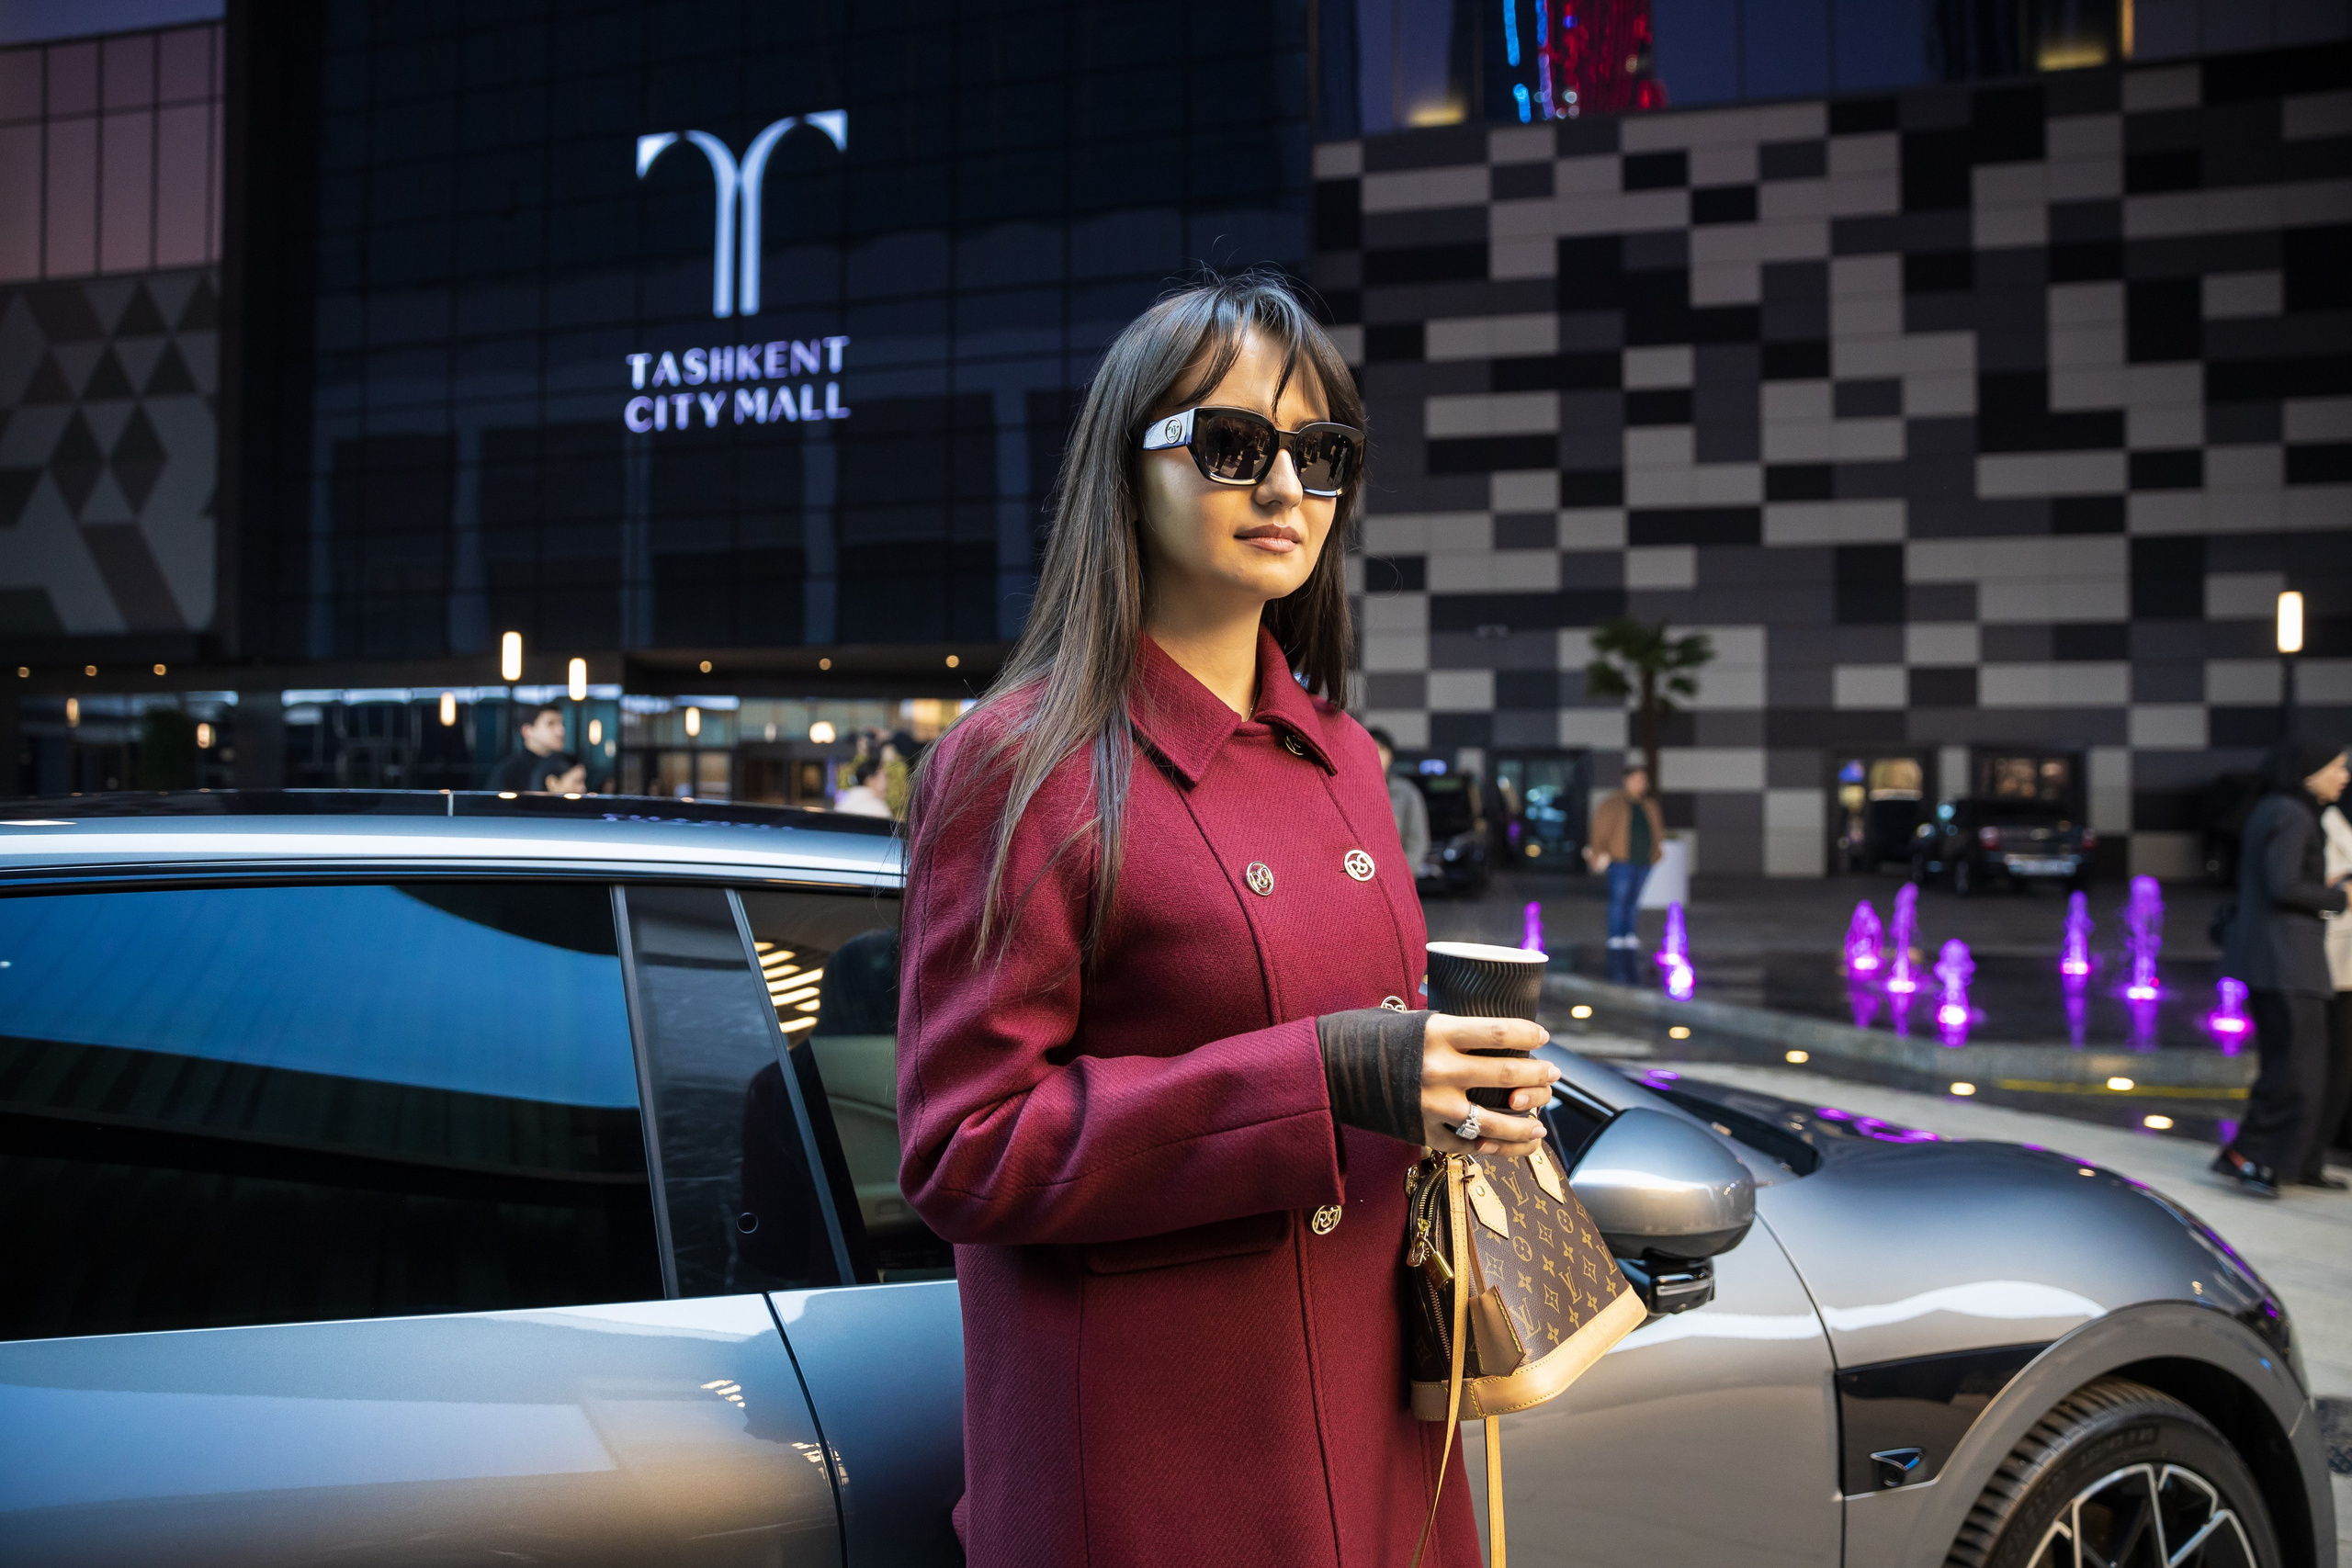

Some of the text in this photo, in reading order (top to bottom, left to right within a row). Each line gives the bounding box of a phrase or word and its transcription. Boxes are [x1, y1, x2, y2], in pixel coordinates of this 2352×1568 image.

[626, 335, 851, 389] TASHKENT
[624, 381, 852, 434] CITY MALL
